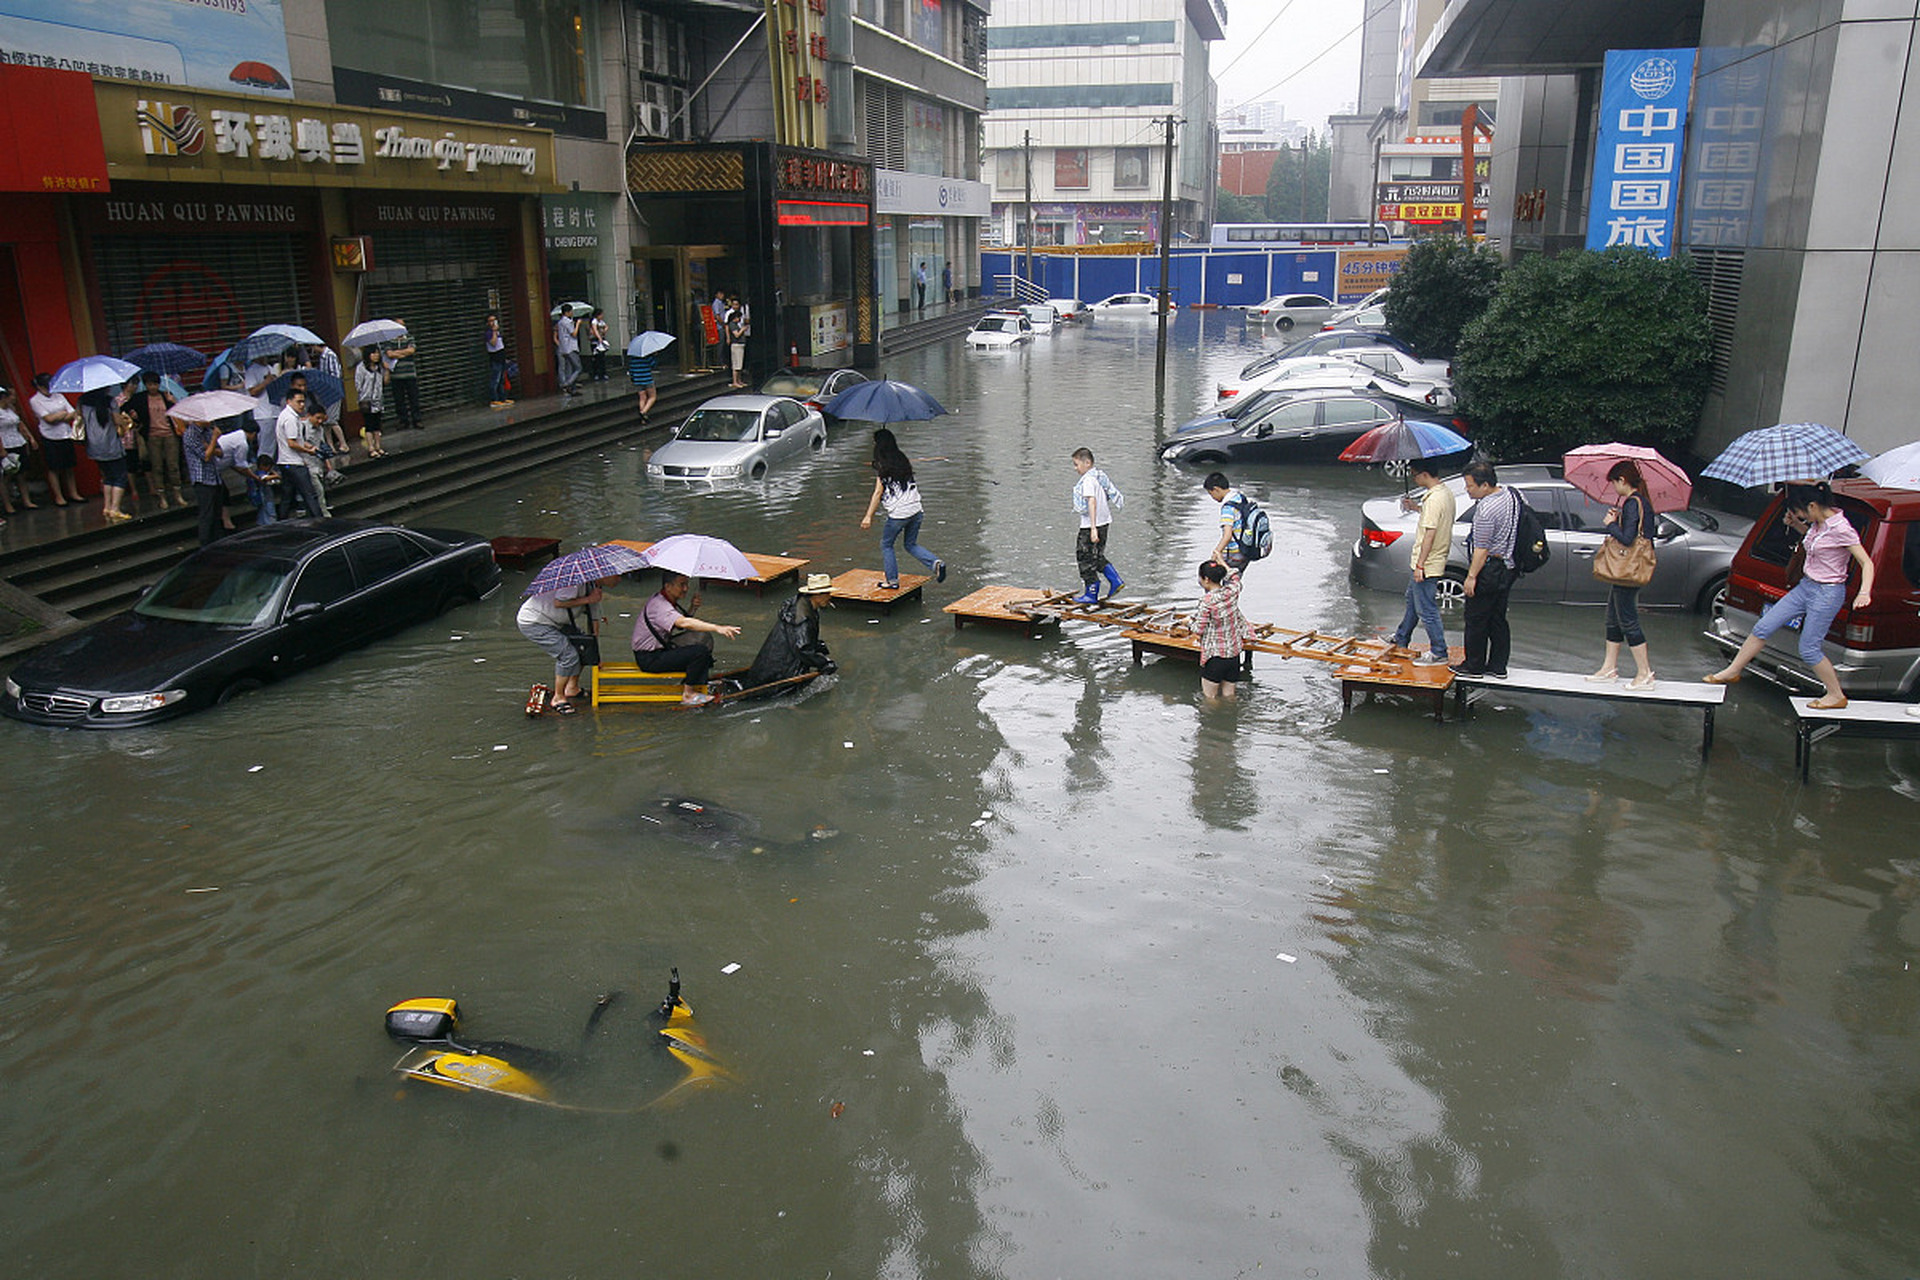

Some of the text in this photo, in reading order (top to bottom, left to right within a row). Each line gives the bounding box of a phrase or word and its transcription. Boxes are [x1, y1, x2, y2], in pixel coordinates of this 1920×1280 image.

[211, 110, 365, 164] 环球典当
[1605, 105, 1678, 247] 中国国旅
[107, 202, 296, 222] HUAN QIU PAWNING
[378, 206, 496, 221] HUAN QIU PAWNING
